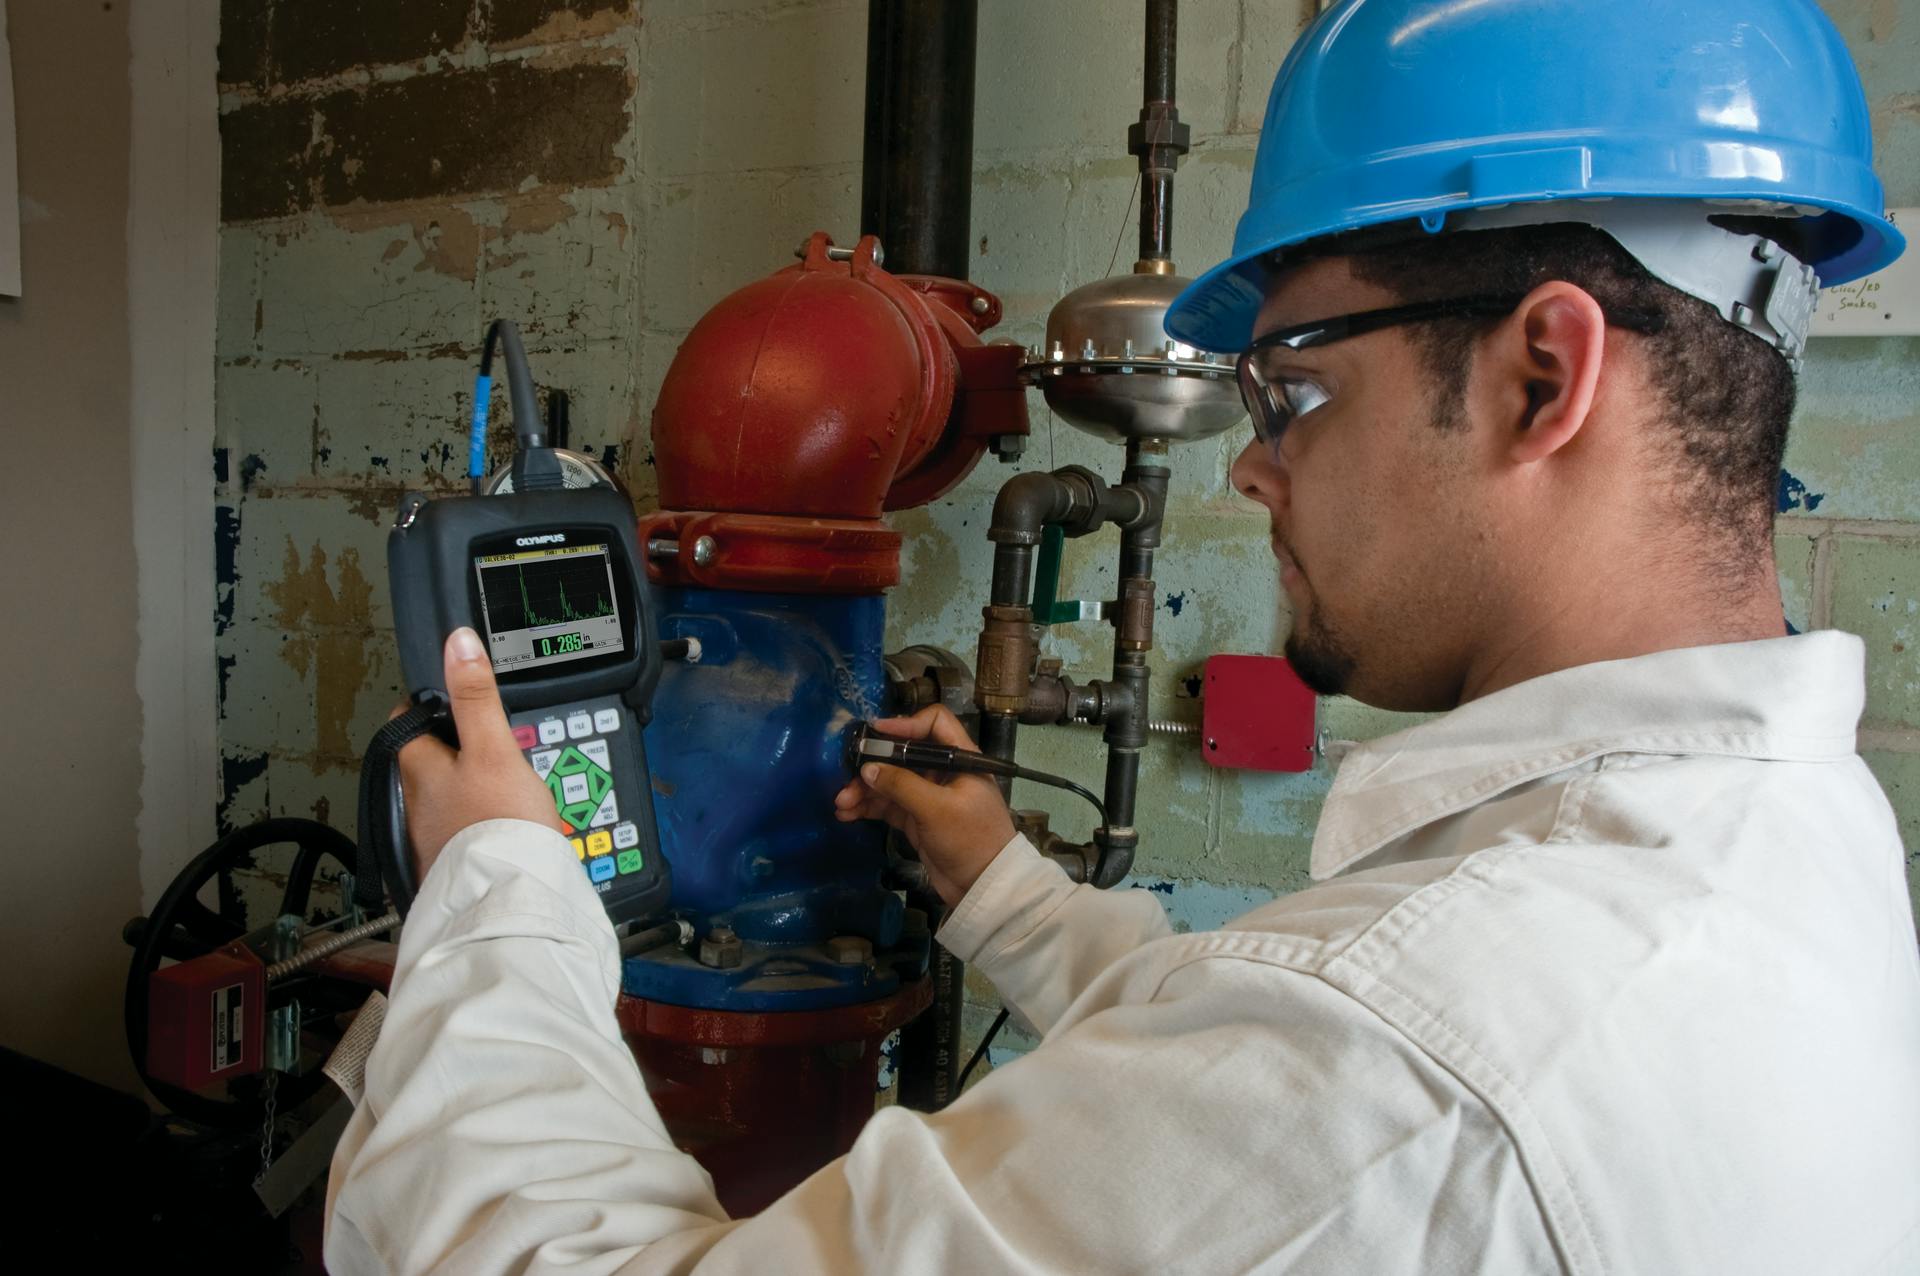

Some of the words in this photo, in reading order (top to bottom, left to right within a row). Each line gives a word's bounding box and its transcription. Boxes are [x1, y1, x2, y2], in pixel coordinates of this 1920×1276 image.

[566, 464, 582, 475] 1200
[516, 534, 566, 546] OLYMPUS
[541, 633, 582, 656] 0.285
[583, 633, 591, 641] in
[575, 721, 585, 730] FILE
[586, 744, 605, 755] FREEZE
[535, 755, 548, 763] SAVE
[567, 784, 584, 793] ENTER
[600, 806, 614, 814] WAVE
[618, 829, 632, 837] SETUP
[595, 864, 610, 874] ZOOM
[936, 1049, 949, 1066] 40
